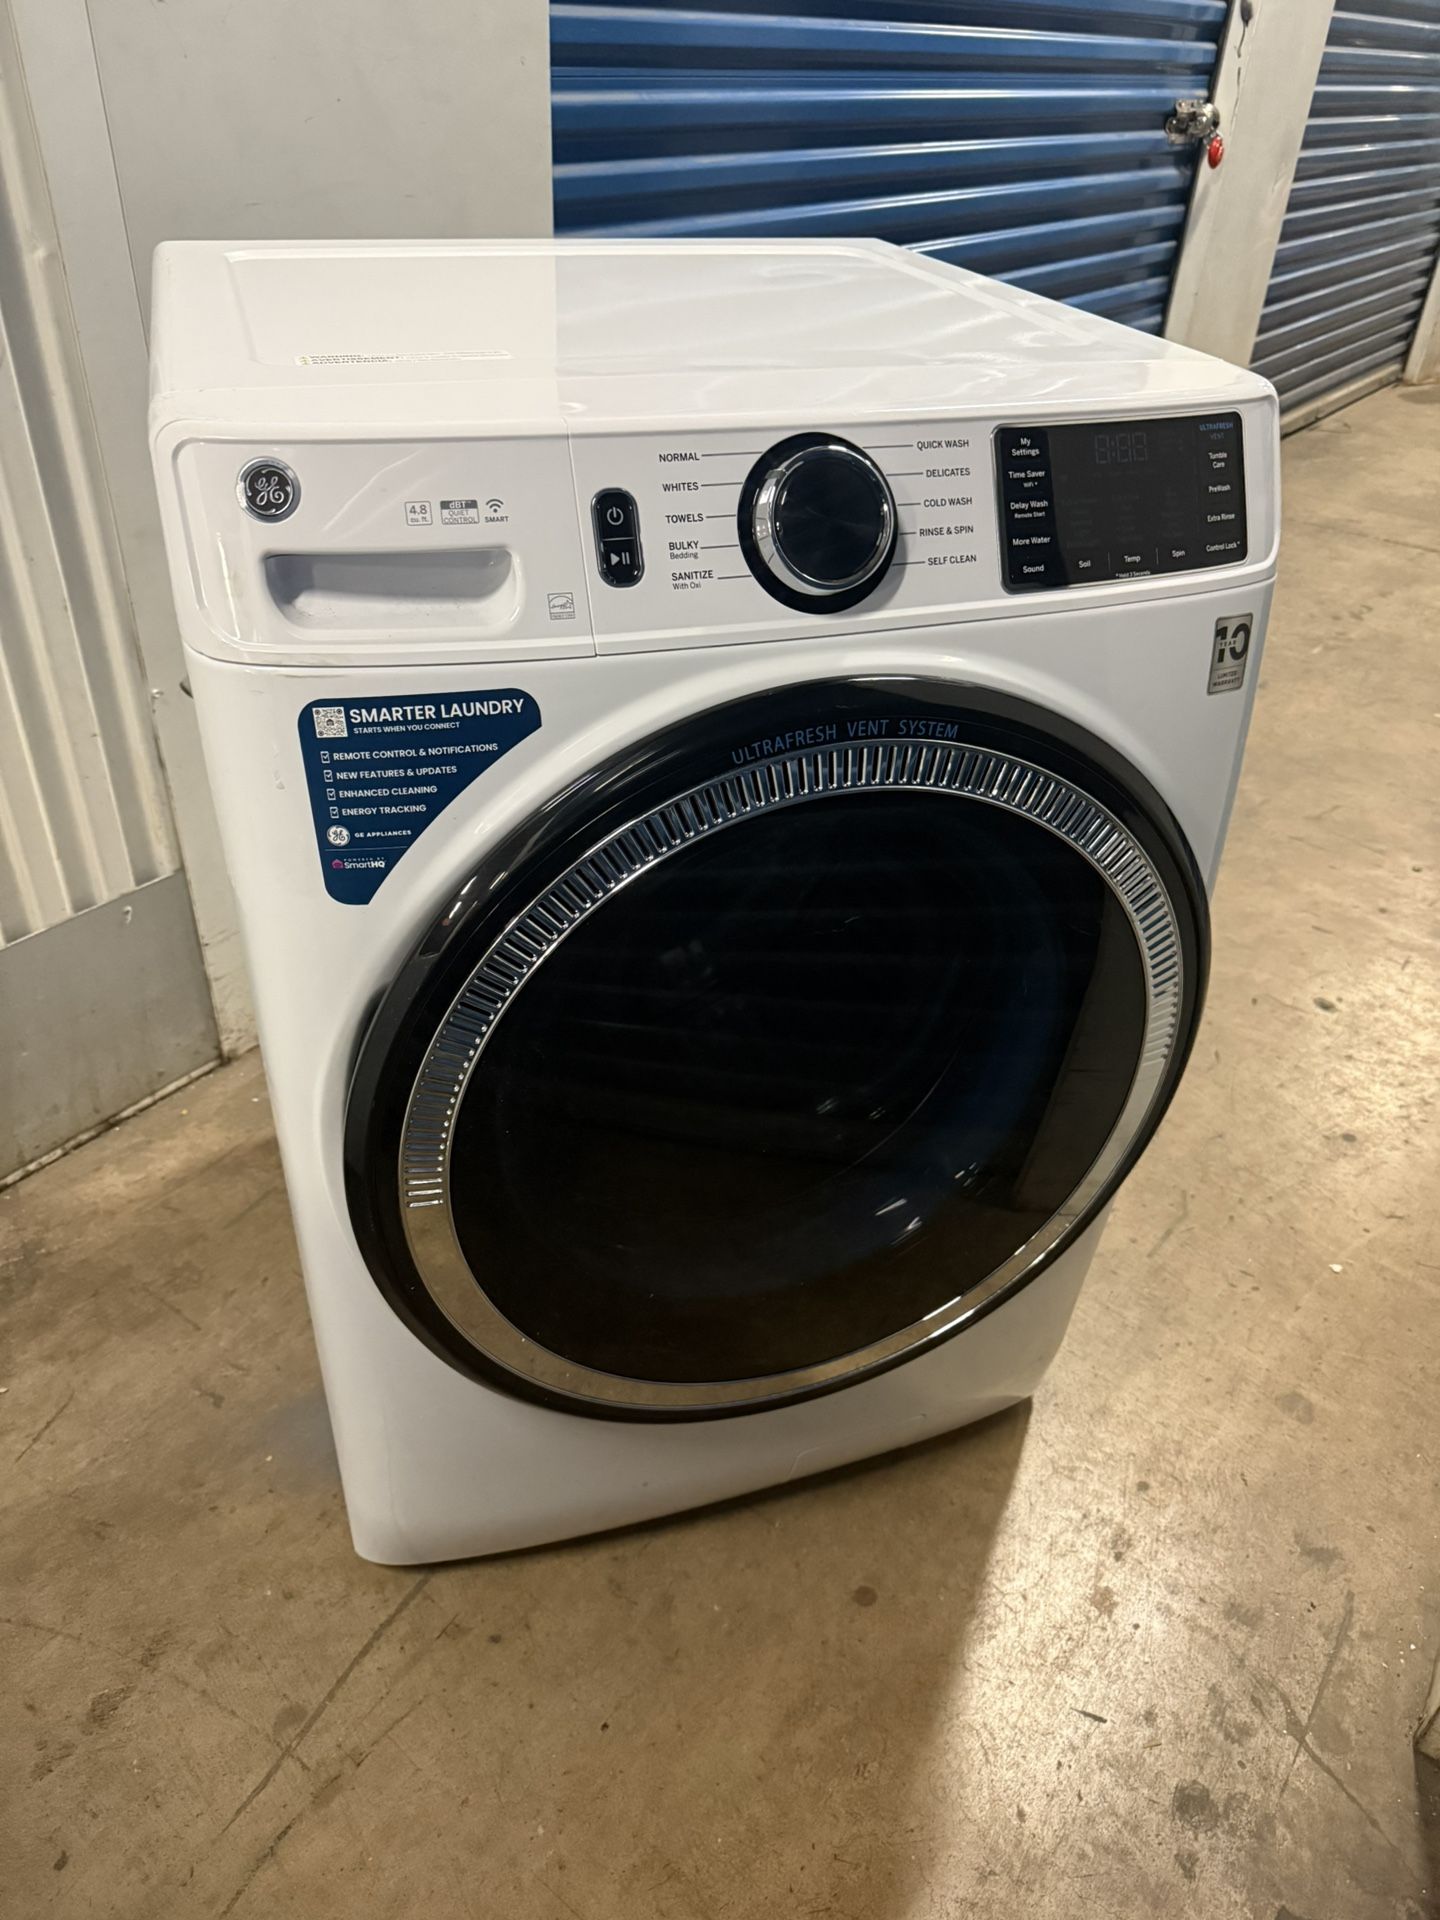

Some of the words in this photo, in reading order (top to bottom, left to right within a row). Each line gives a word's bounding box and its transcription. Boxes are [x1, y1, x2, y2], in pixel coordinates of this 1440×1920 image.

[916, 440, 943, 451] QUICK
[944, 439, 969, 448] WASH
[1020, 438, 1031, 447] My
[658, 452, 700, 463] NORMAL
[1011, 448, 1040, 457] Settings
[1208, 452, 1228, 460] Tumble
[1212, 461, 1226, 469] Care
[926, 467, 970, 478] DELICATES
[1008, 470, 1026, 479] Time
[1026, 469, 1046, 478] Saver
[662, 481, 699, 492] WHITES
[1208, 484, 1231, 493] PreWash
[923, 498, 947, 508] COLD
[948, 497, 973, 506] WASH
[1010, 501, 1030, 510] Delay
[1030, 499, 1049, 508] Wash
[409, 504, 428, 516] 4.8
[443, 517, 478, 525] CONTROL
[665, 513, 704, 524] TOWELS
[1207, 514, 1221, 522] Extra
[1221, 512, 1236, 521] Rinse
[919, 527, 945, 537] RINSE
[946, 527, 953, 535] &
[954, 525, 974, 535] SPIN
[668, 541, 700, 551] BULKY
[1012, 538, 1030, 546] More
[1030, 536, 1051, 545] Water
[1206, 544, 1225, 552] Control
[1225, 542, 1237, 550] Lock
[669, 551, 699, 560] Bedding
[1124, 554, 1141, 564] Temp
[1172, 550, 1186, 559] Spin
[927, 556, 948, 566] SELF
[949, 554, 977, 565] CLEAN
[1078, 560, 1091, 568] Soil
[1022, 564, 1045, 573] Sound
[671, 570, 714, 581] SANITIZE
[672, 582, 689, 590] With
[690, 581, 702, 589] Oxi
[1216, 623, 1250, 663] 10
[350, 705, 436, 723] SMARTER
[441, 699, 525, 719] LAUNDRY
[353, 726, 382, 734] STARTS
[383, 725, 406, 733] WHEN
[407, 723, 424, 731] YOU
[424, 721, 460, 730] CONNECT
[731, 723, 837, 765] ULTRAFRESH
[847, 719, 890, 737] VENT
[898, 719, 959, 739] SYSTEM
[333, 751, 371, 761] REMOTE
[372, 749, 417, 760] CONTROL
[419, 748, 426, 756] &
[428, 743, 499, 755] NOTIFICATIONS
[336, 771, 358, 780] NEW
[359, 768, 405, 778] FEATURES
[407, 768, 414, 776] &
[416, 765, 457, 775] UPDATES
[339, 789, 390, 798] ENHANCED
[391, 786, 438, 796] CLEANING
[342, 807, 378, 816] ENERGY
[379, 804, 427, 814] TRACKING
[366, 830, 412, 838] APPLIANCES
[343, 860, 386, 869] SmartHQ
